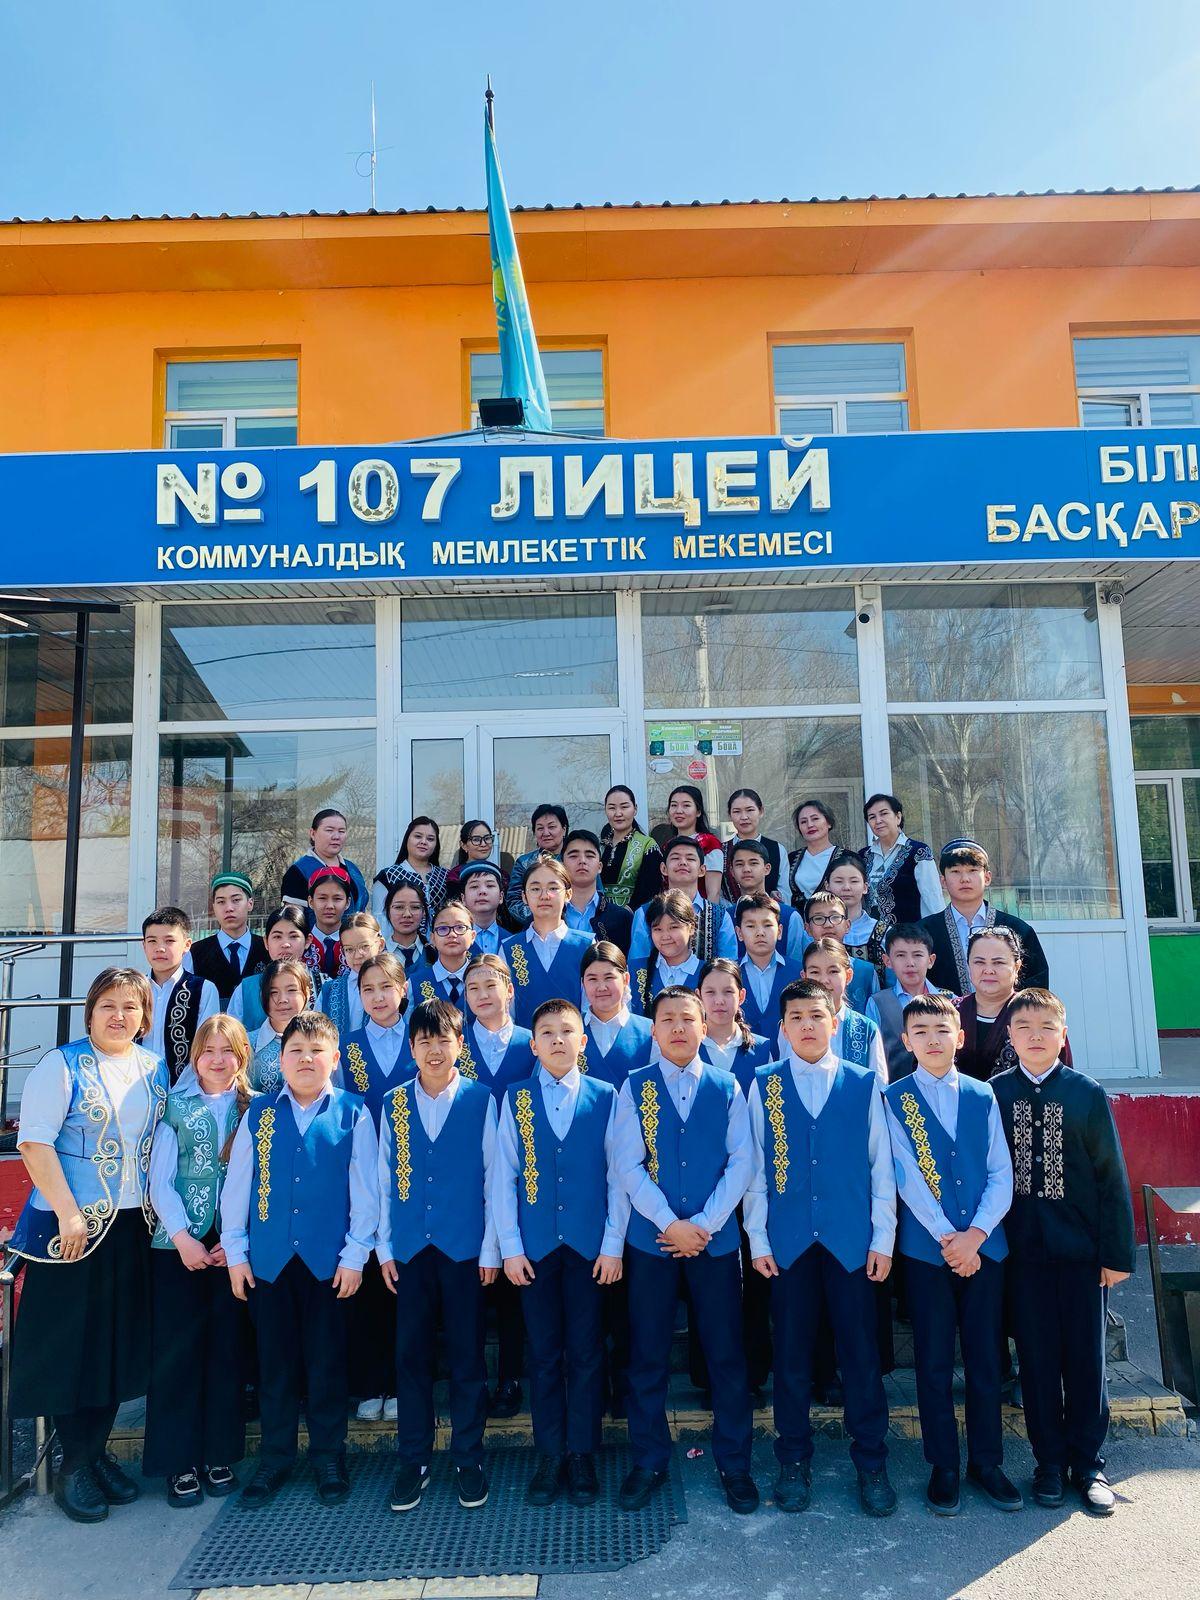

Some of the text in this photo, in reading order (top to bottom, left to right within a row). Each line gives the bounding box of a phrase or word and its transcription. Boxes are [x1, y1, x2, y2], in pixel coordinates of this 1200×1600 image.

[299, 457, 462, 525] 107
[491, 435, 832, 528] ЛИЦЕЙ
[157, 530, 834, 571] КОММУНАЛДЫҚ МЕМЛЕКЕТТІК МЕКЕМЕСІ
